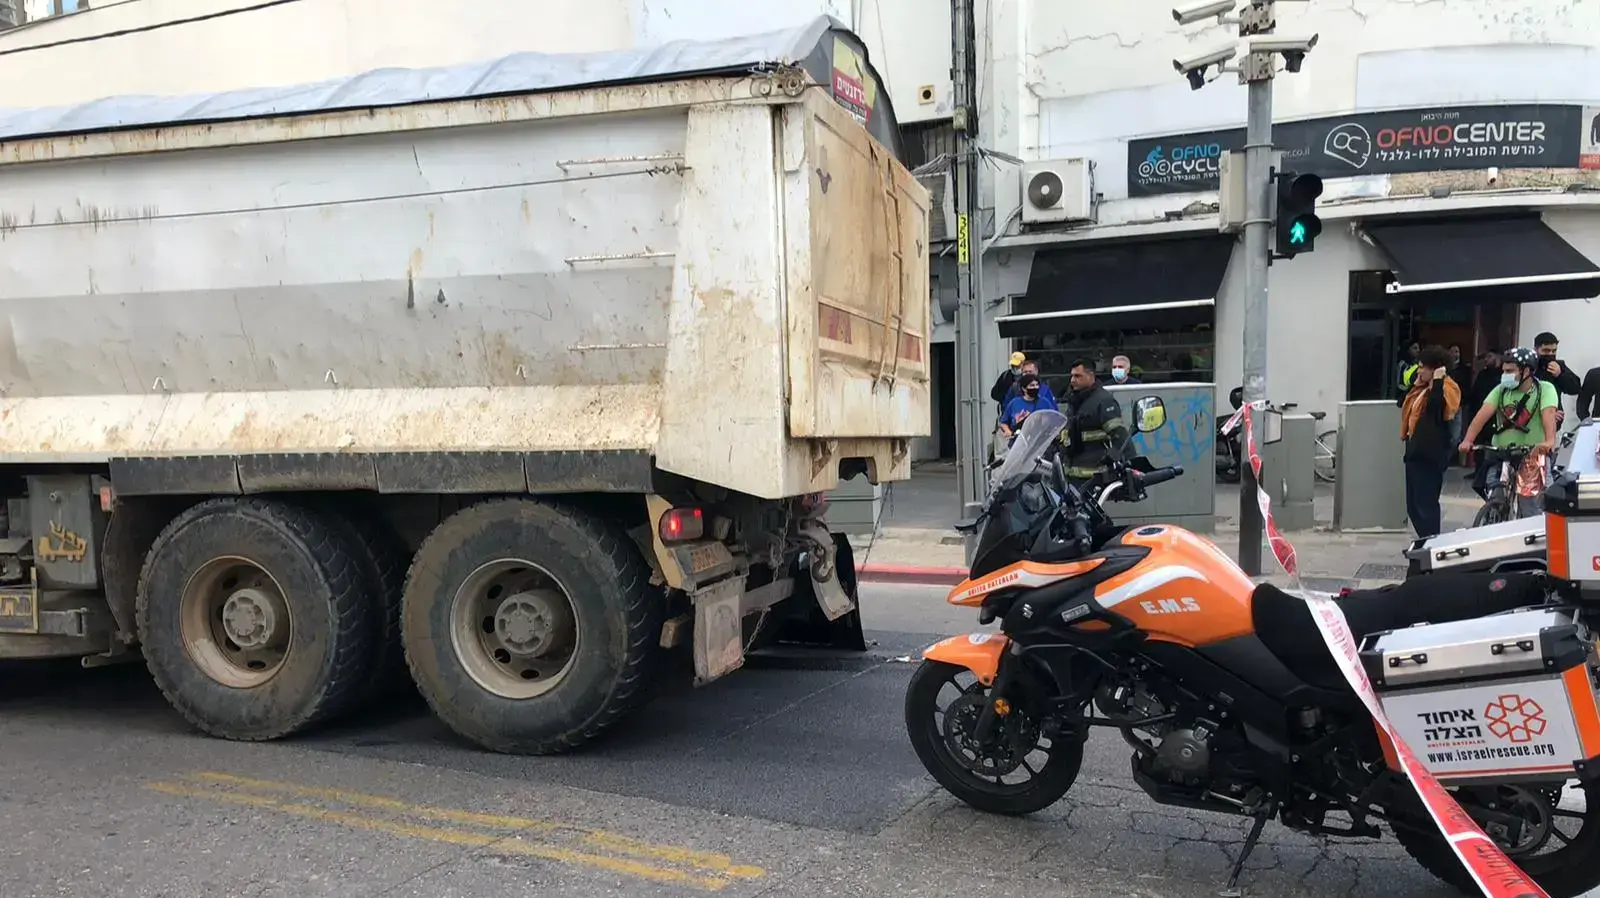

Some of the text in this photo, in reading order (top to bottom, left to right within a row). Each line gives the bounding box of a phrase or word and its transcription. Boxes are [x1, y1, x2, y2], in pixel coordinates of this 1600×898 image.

[1376, 121, 1546, 148] OFNOCENTER
[1172, 143, 1220, 161] OFNO
[1376, 148, 1440, 161] לדו-גלגלי
[1444, 146, 1497, 158] המובילה
[1172, 157, 1221, 175] CYCL
[959, 215, 967, 262] 3541
[1140, 597, 1200, 614] E.M.S
[1417, 708, 1477, 725] איחוד
[1424, 725, 1482, 741] הצלה
[1427, 743, 1556, 764] www.israelrescue.org
